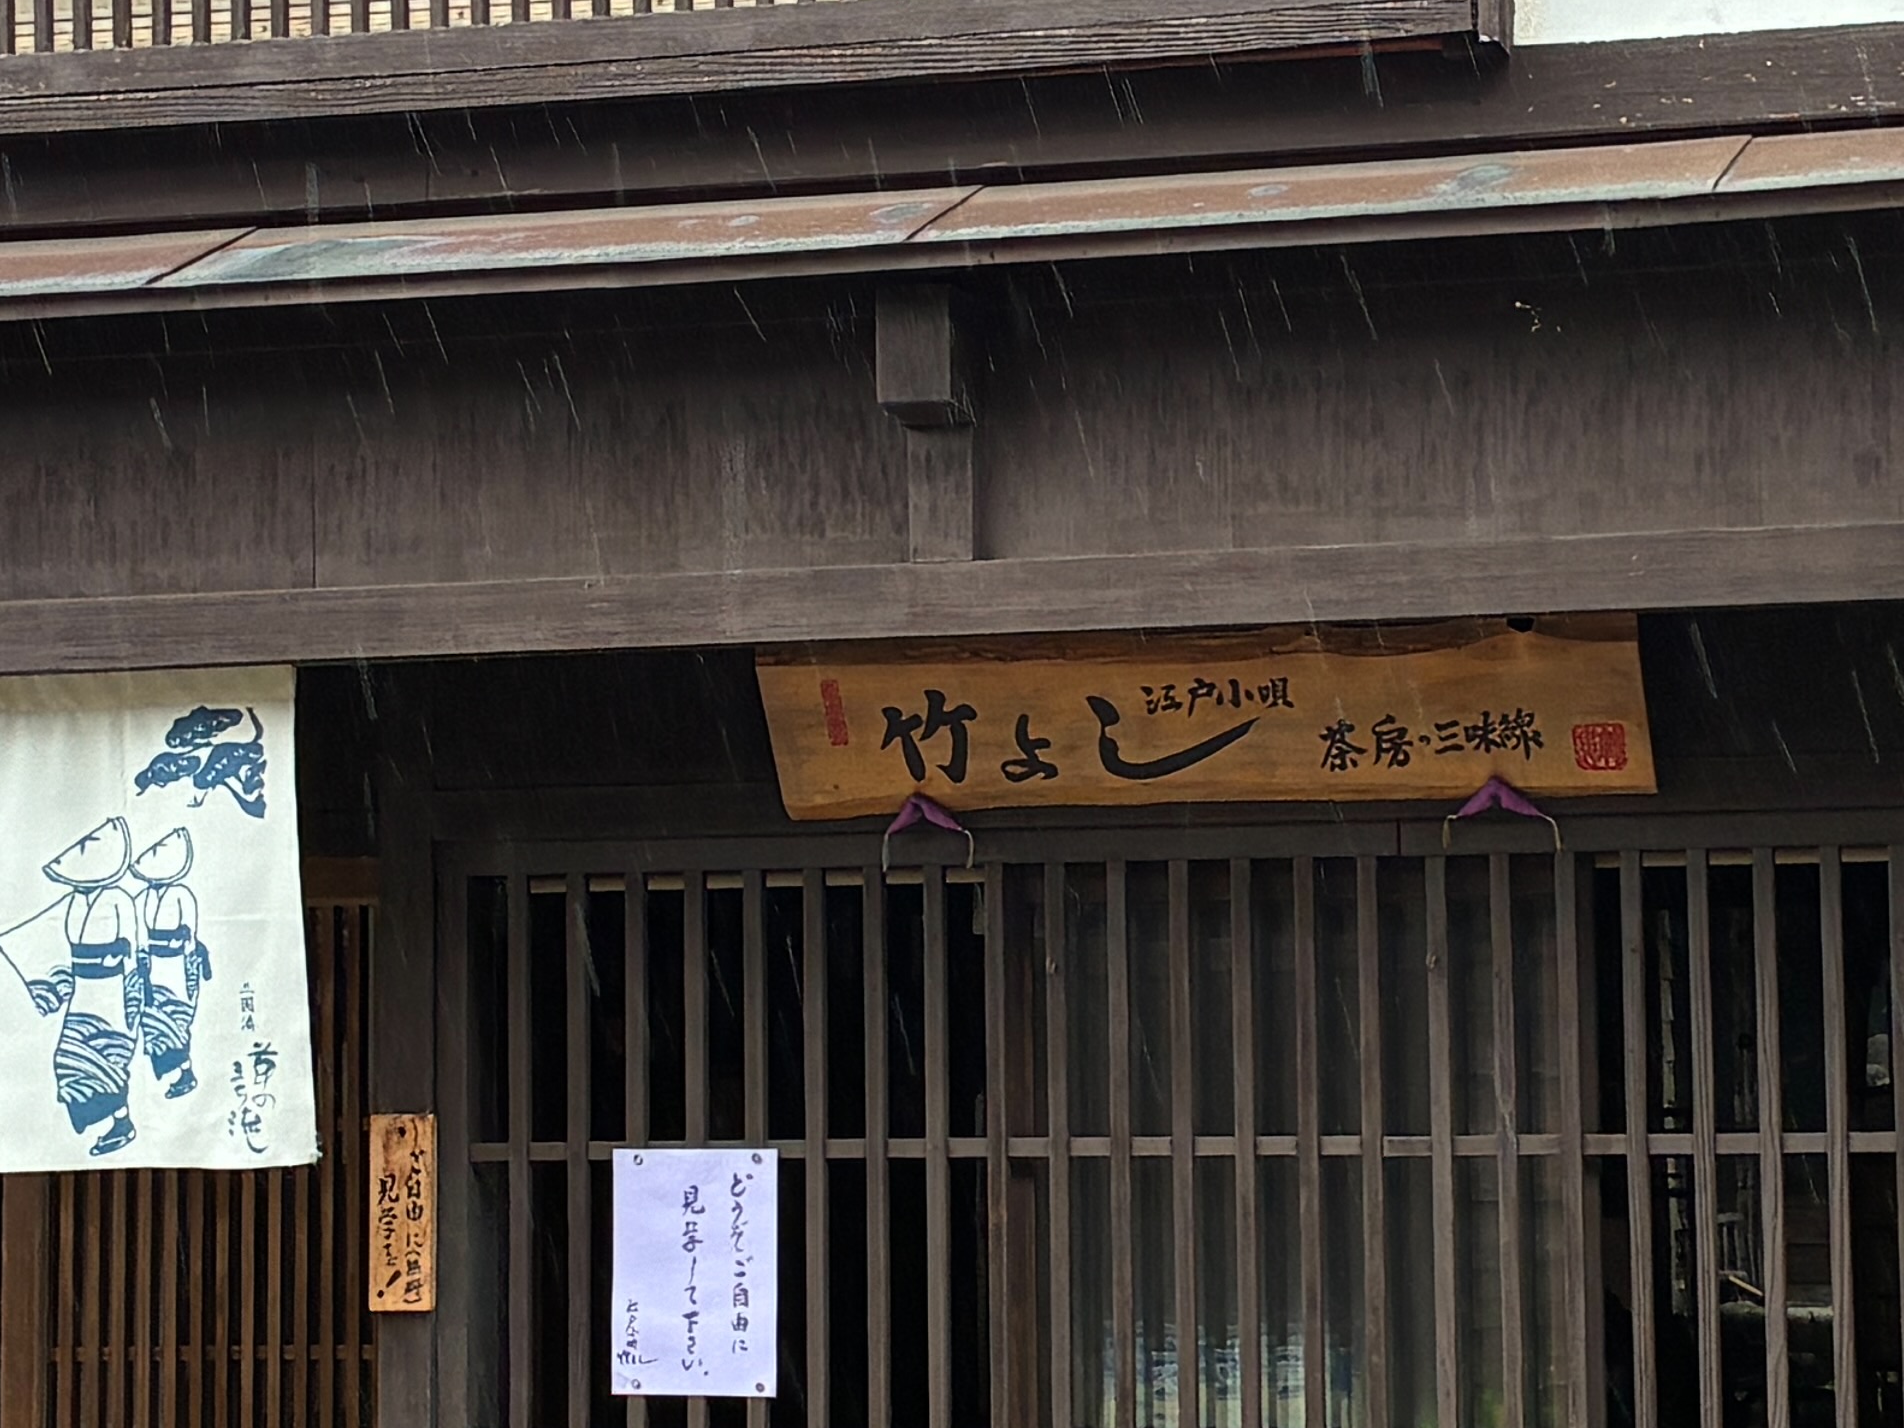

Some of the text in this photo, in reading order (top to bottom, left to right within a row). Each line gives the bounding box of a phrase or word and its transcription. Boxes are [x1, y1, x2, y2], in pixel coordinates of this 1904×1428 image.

[881, 687, 1261, 785] 竹よし
[1140, 676, 1296, 715] 江戸小唄
[729, 1172, 755, 1354] どうぞご自由に
